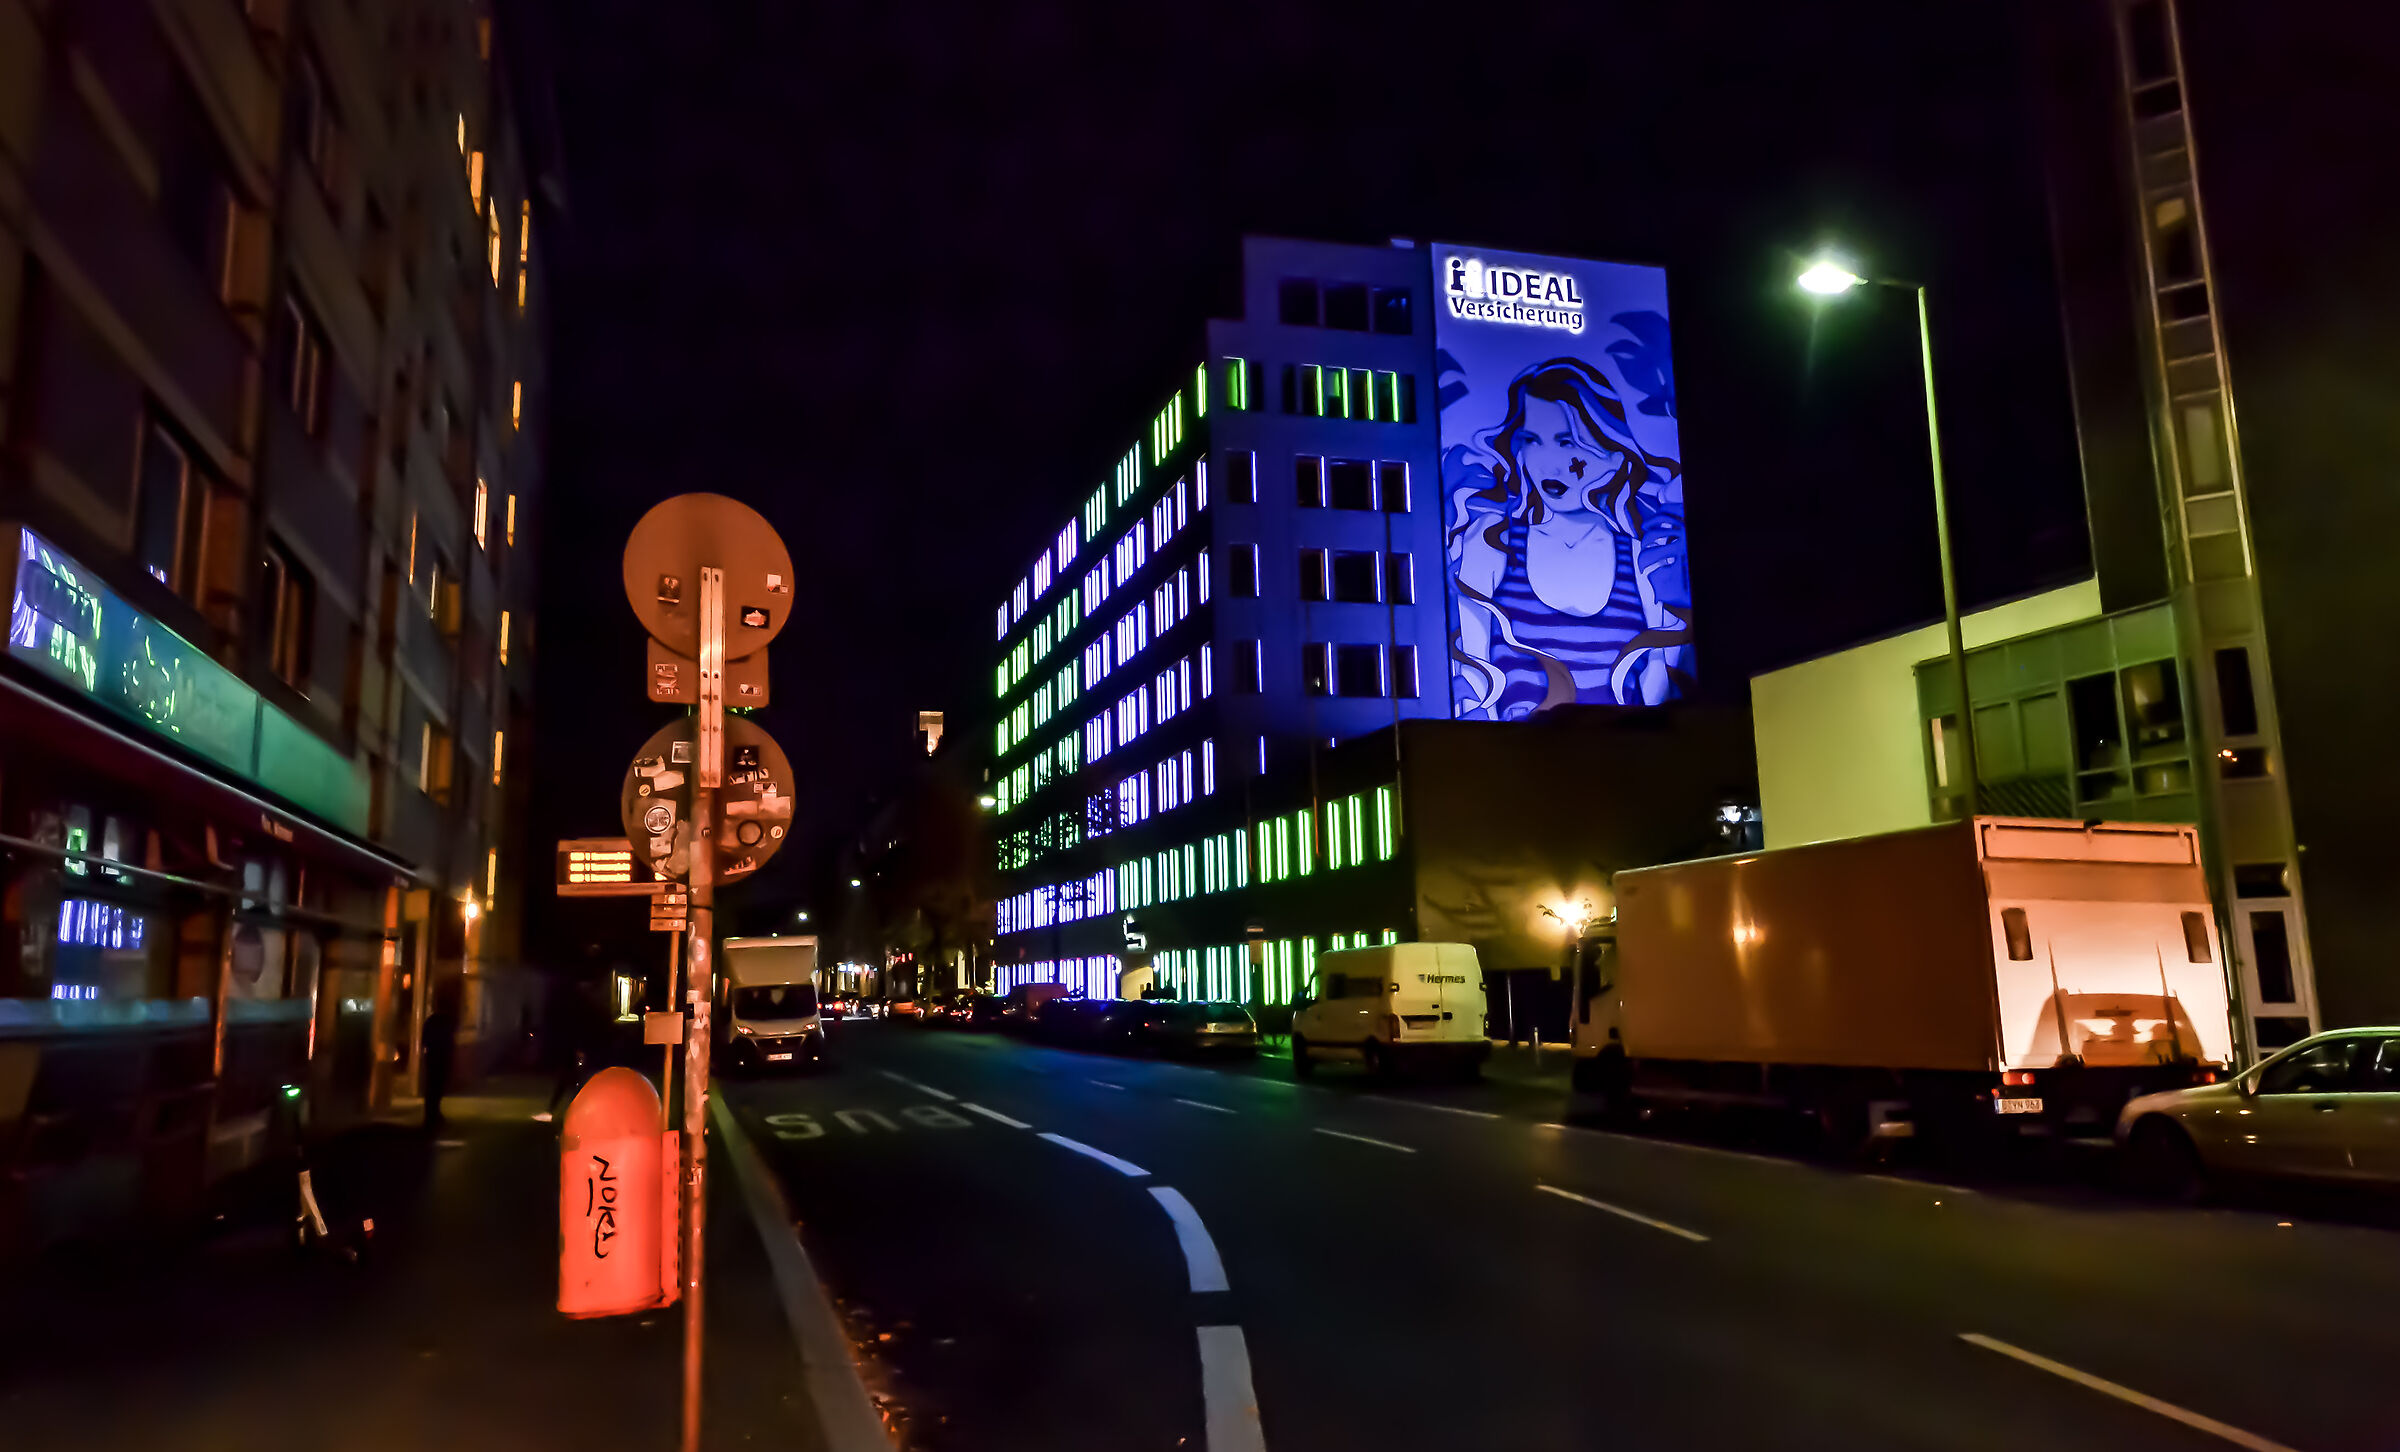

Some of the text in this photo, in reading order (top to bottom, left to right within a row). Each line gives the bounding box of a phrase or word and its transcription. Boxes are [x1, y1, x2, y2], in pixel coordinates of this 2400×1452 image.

[1490, 270, 1583, 304] IDEAL
[1451, 297, 1584, 330] Versicherung
[1426, 973, 1467, 984] Hermes
[764, 1104, 975, 1141] BUS
